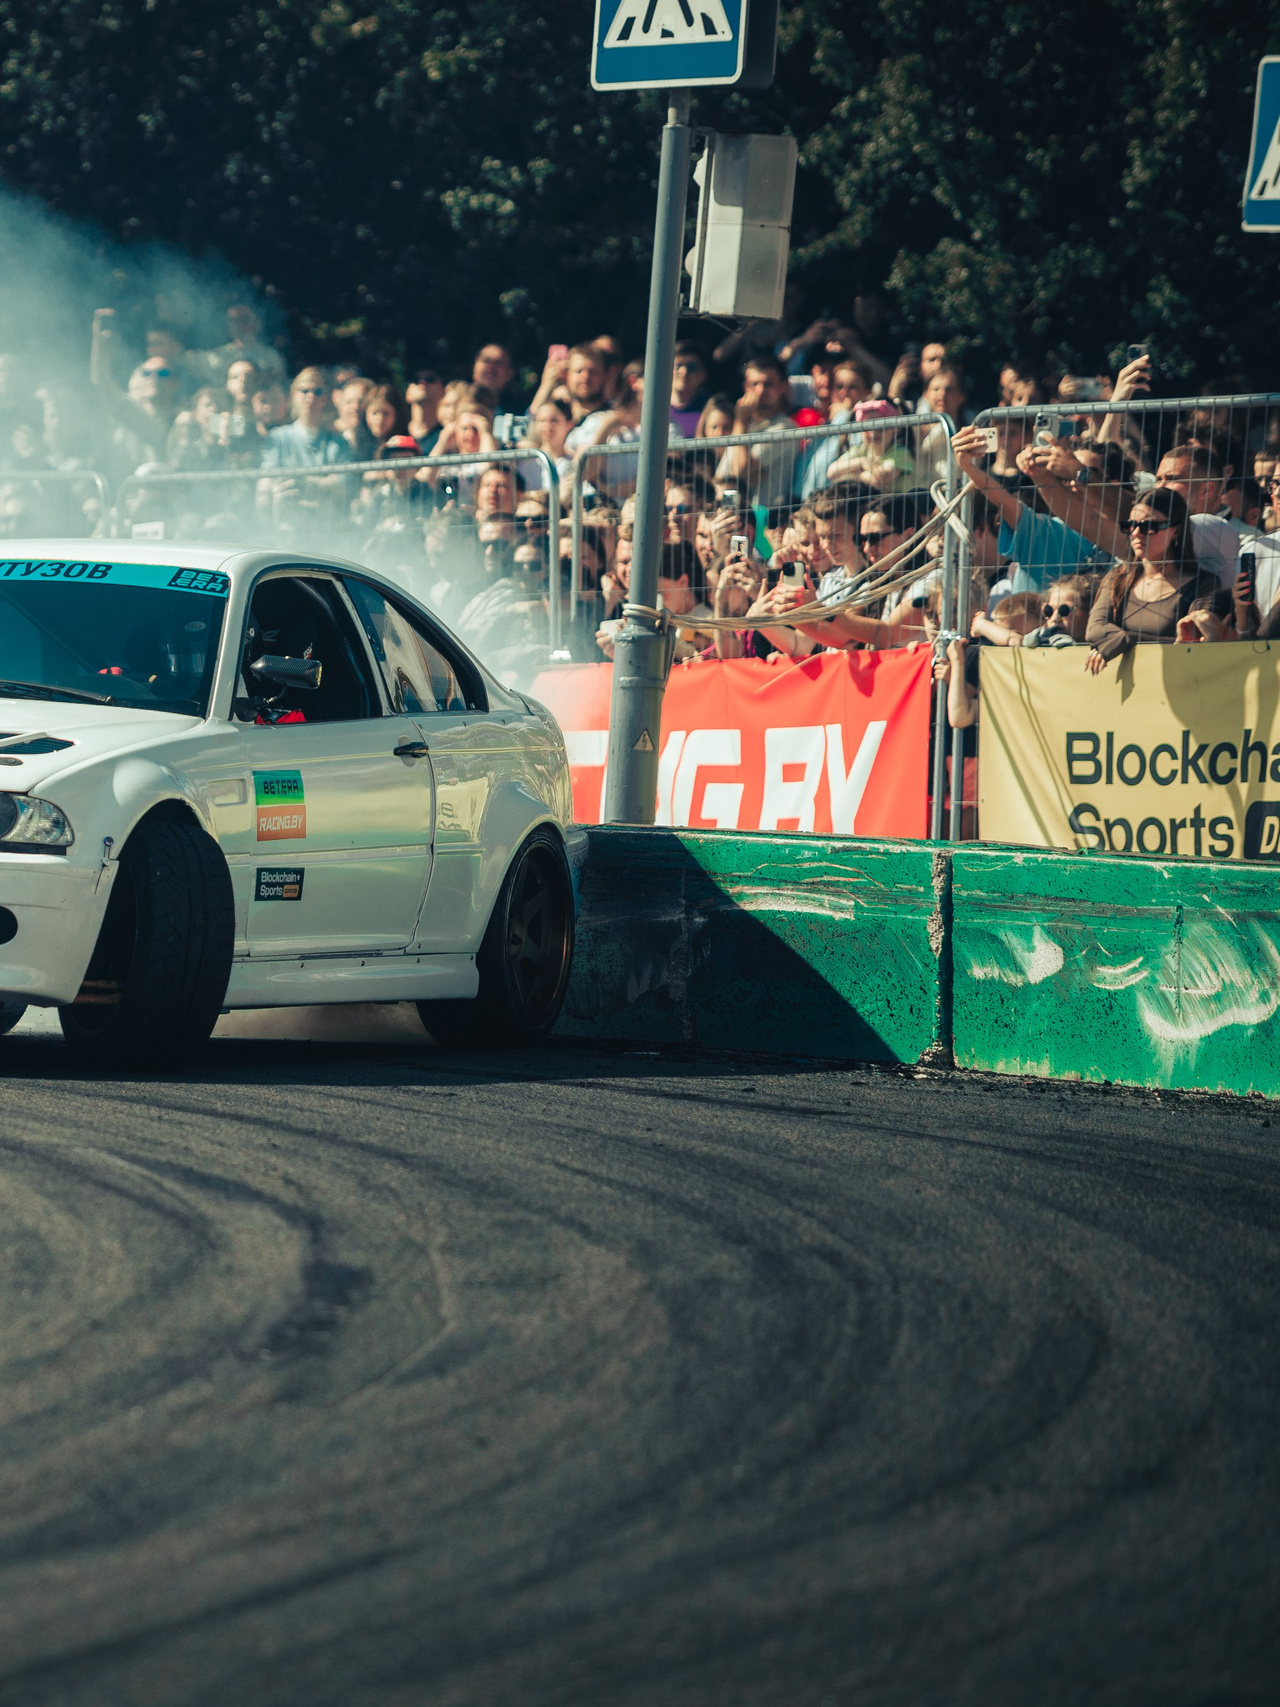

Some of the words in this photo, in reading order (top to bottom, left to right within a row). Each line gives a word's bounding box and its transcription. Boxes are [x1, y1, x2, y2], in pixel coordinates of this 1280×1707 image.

[180, 571, 229, 584] BET
[259, 815, 304, 832] RACING.BY
[261, 871, 297, 883] Blockchain
[260, 884, 283, 898] Sports
